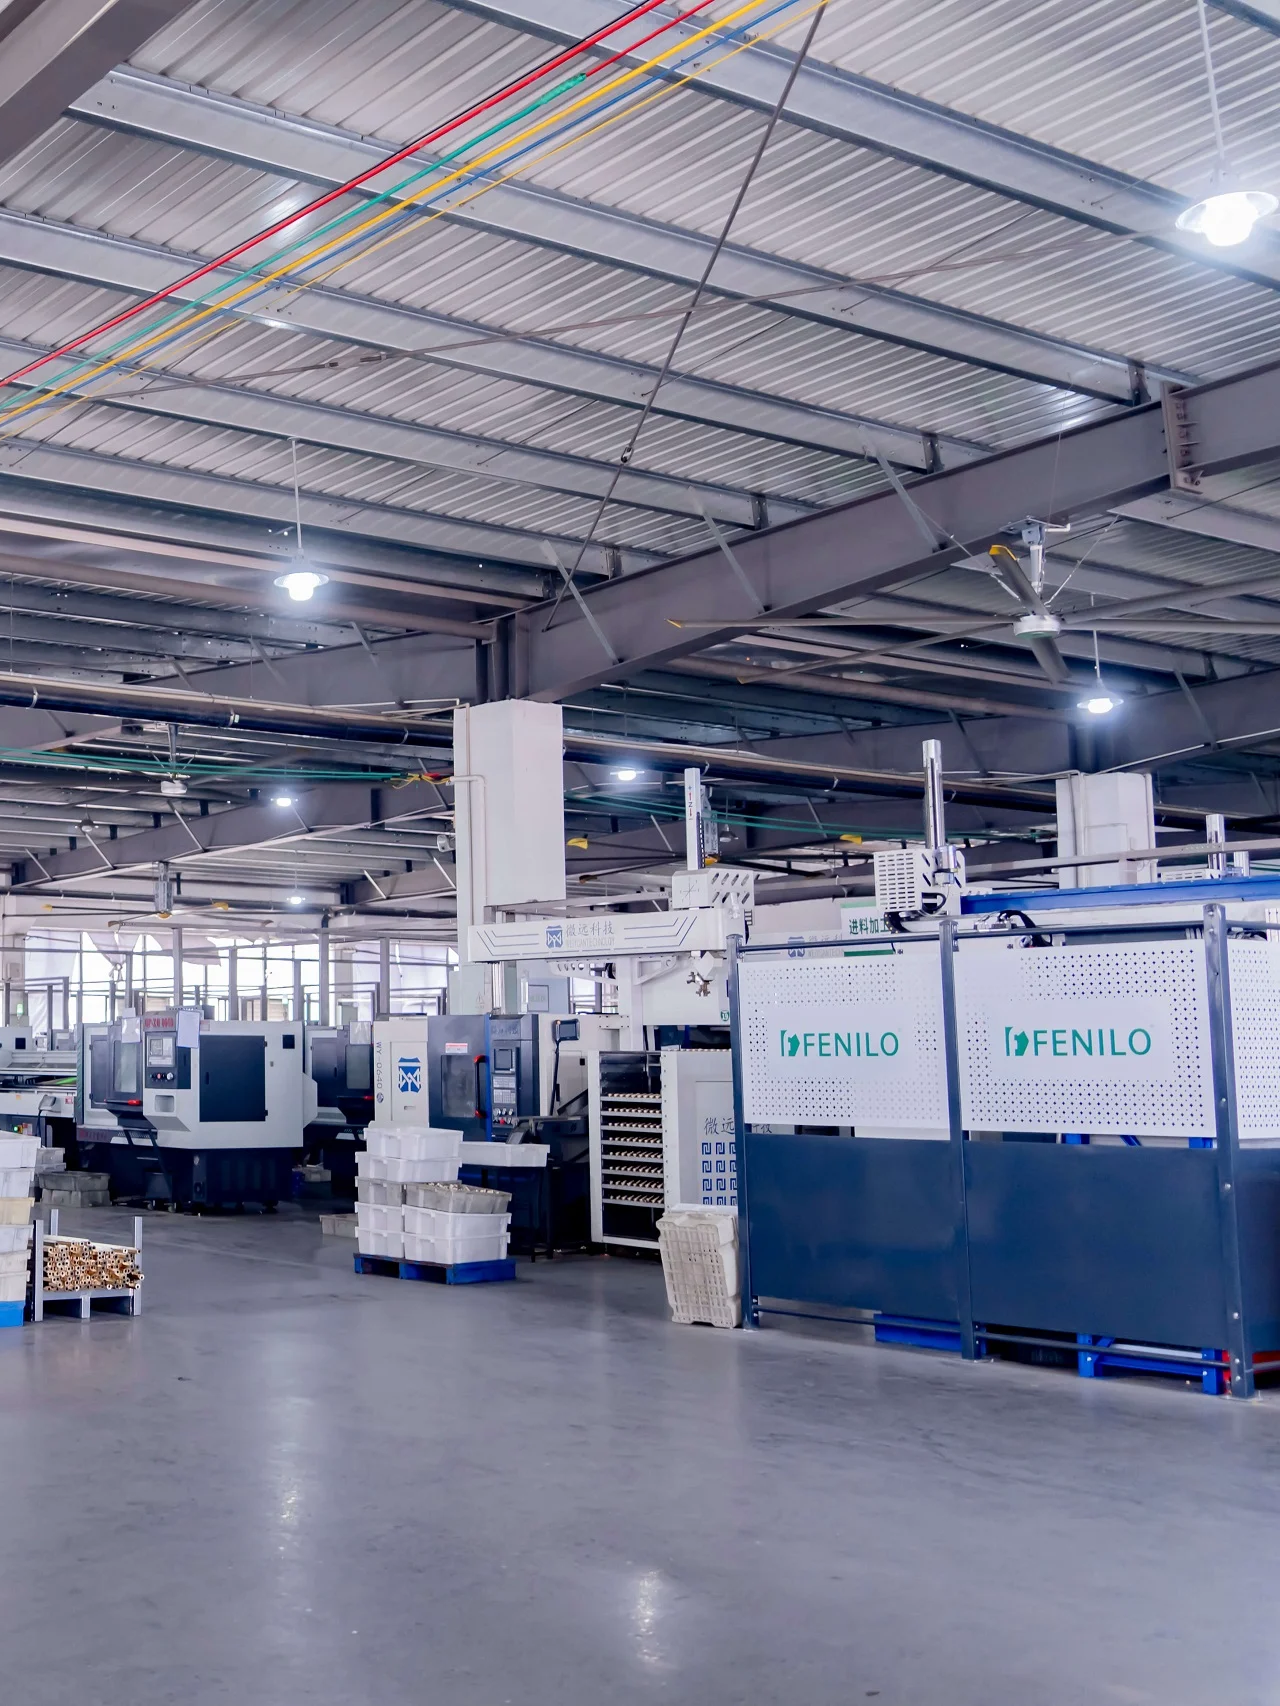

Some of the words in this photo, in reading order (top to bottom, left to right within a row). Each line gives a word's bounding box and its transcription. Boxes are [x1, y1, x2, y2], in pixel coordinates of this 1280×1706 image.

[566, 920, 615, 937] 微远科技
[803, 1032, 899, 1057] FENILO
[1033, 1028, 1152, 1057] FENILO
